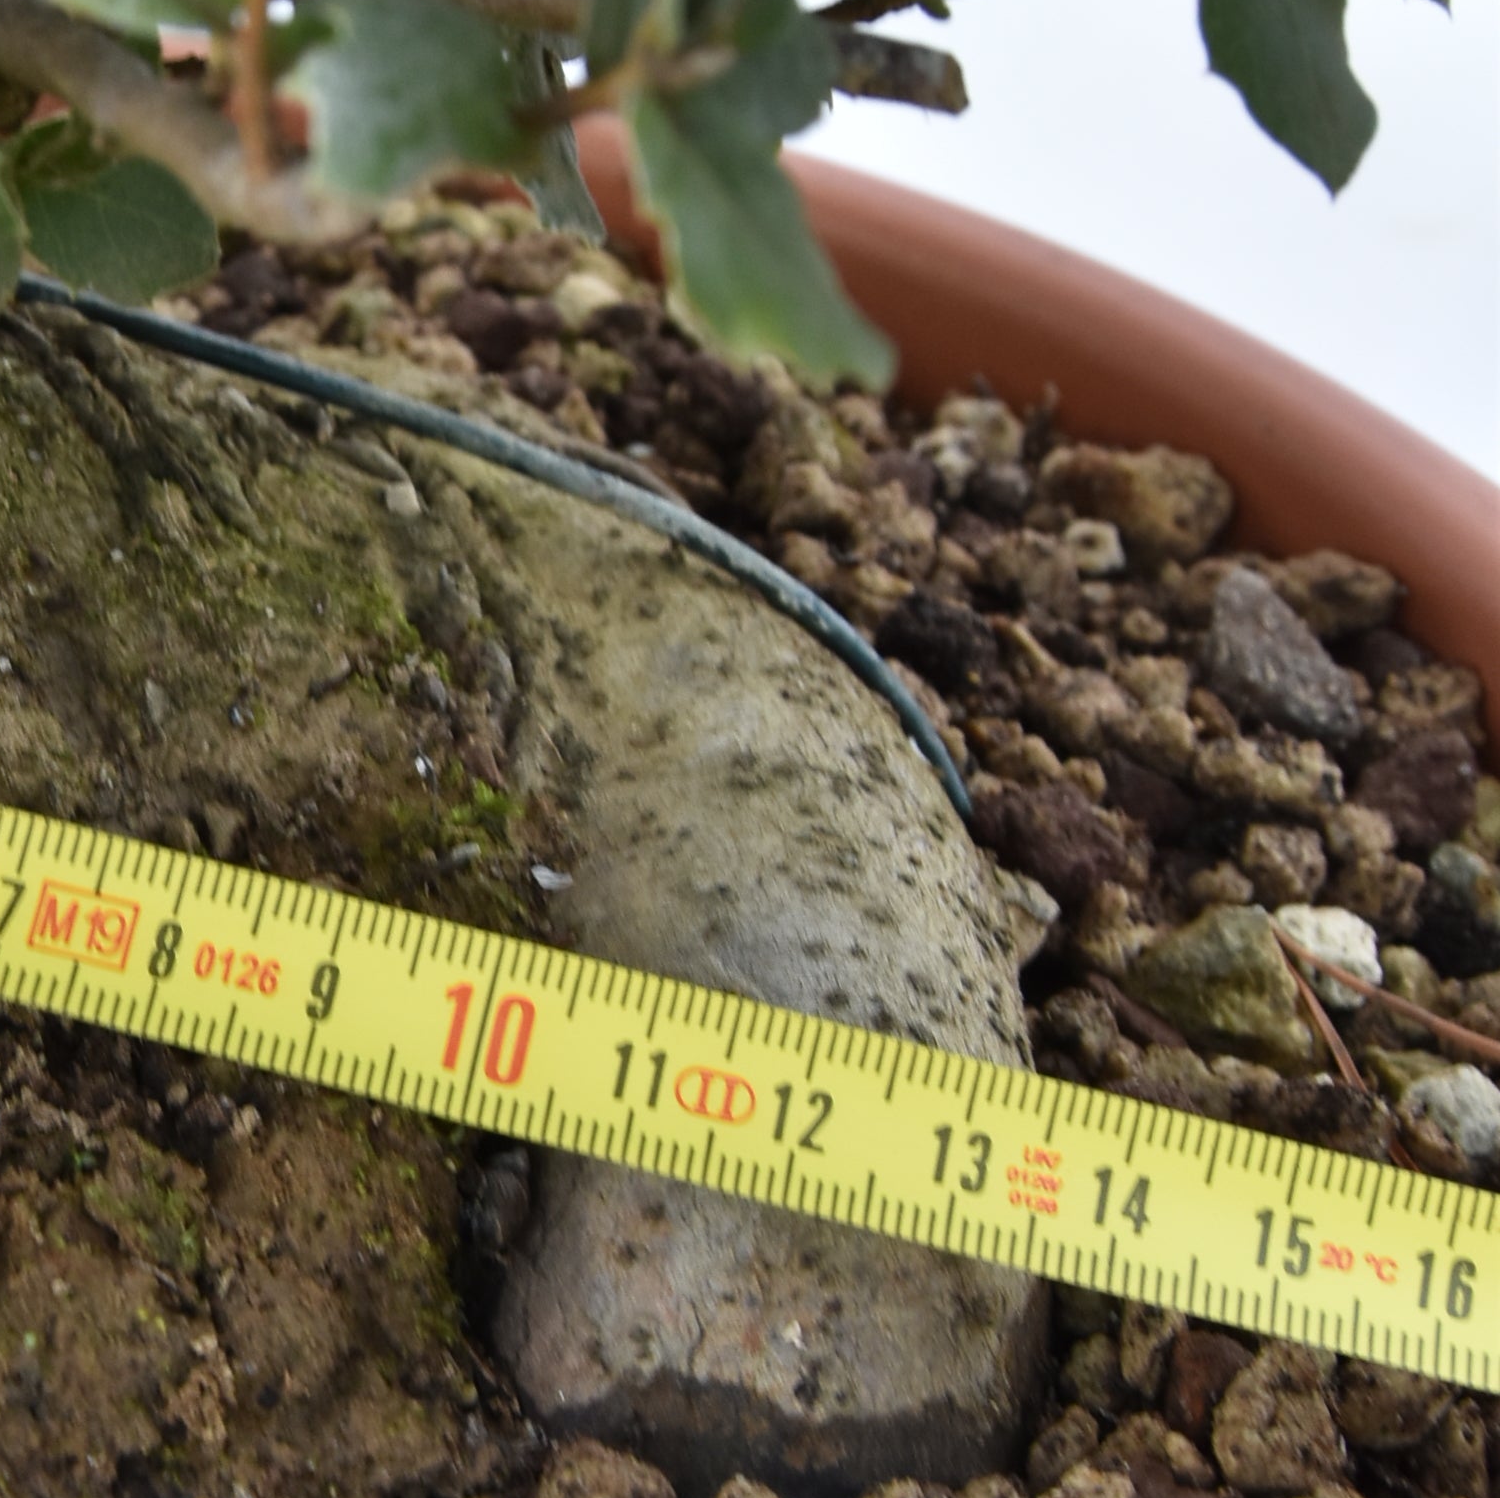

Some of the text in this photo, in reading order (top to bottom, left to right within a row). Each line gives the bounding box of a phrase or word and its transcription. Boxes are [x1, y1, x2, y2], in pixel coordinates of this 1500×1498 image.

[148, 921, 183, 979] 8
[193, 942, 280, 996] 0126
[306, 961, 340, 1021] 9
[441, 981, 536, 1086] 10
[613, 1042, 667, 1108] 11
[774, 1082, 834, 1154] 12
[933, 1123, 992, 1194] 13
[1094, 1165, 1150, 1236] 14
[1255, 1206, 1314, 1278] 15
[1416, 1249, 1476, 1320] 16
